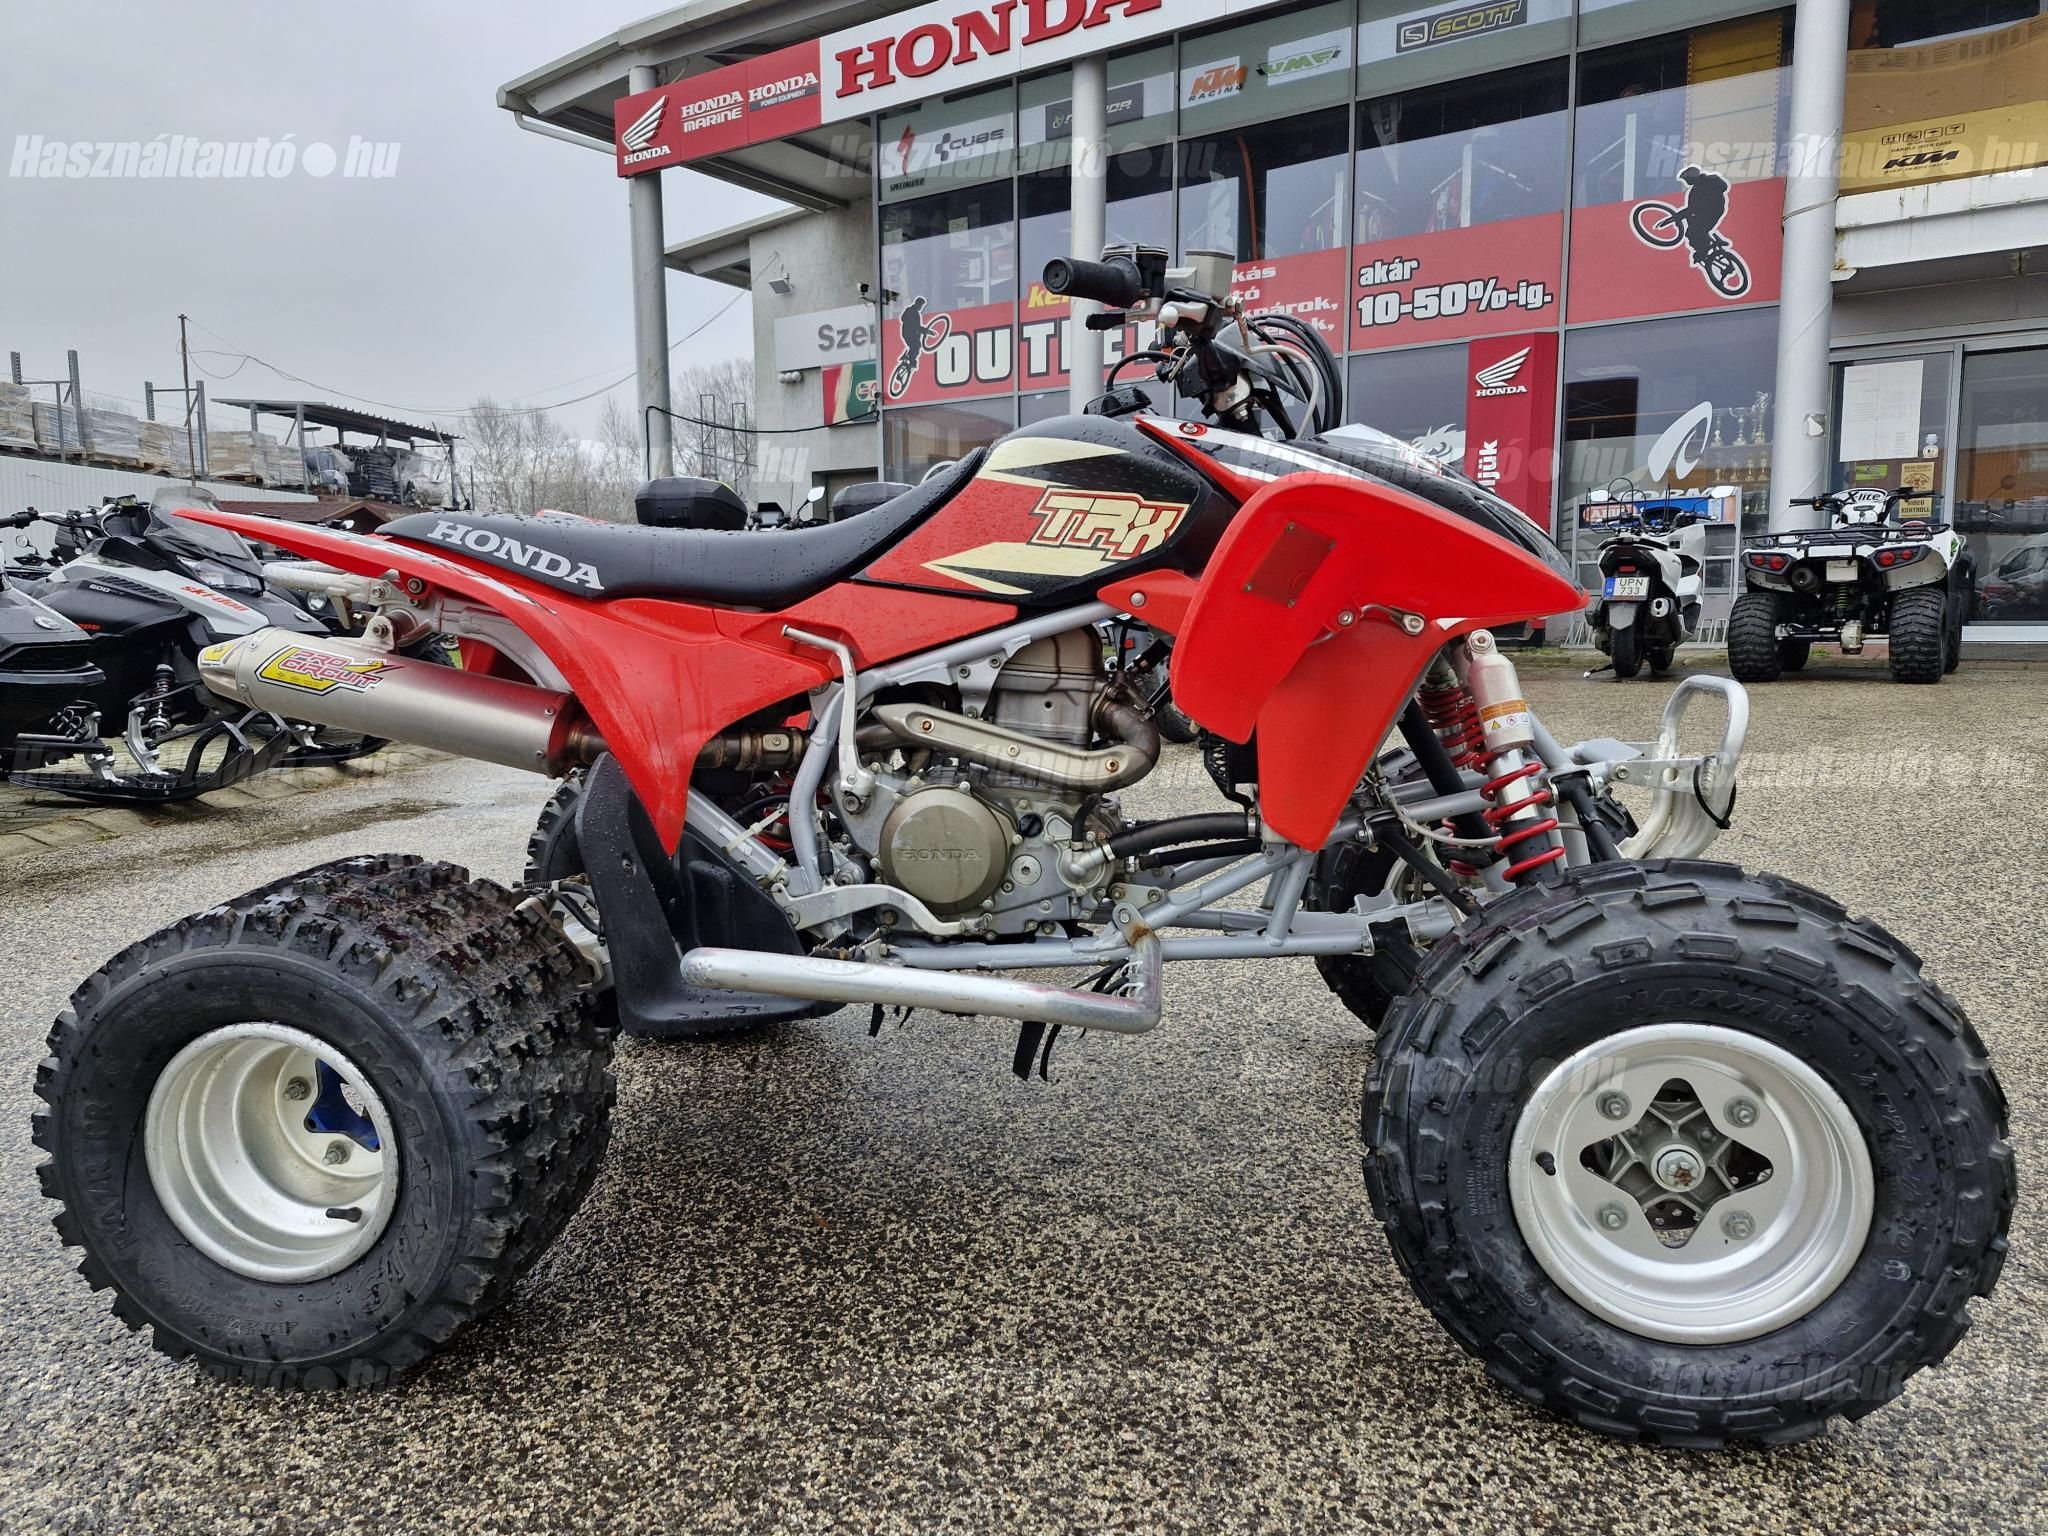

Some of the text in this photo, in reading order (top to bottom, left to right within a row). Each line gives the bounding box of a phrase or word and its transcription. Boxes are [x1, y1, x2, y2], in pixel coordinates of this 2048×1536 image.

[1434, 1, 1520, 37] SCOTT
[747, 71, 819, 102] HONDA
[1190, 63, 1249, 96] KTM
[680, 90, 745, 118] HONDA
[760, 97, 778, 108] POWER
[1188, 83, 1244, 102] RACING
[683, 107, 743, 133] MARINE
[949, 128, 1005, 150] CUBE
[623, 145, 672, 165] HONDA
[1882, 149, 1960, 170] KTM
[1231, 265, 1277, 283] kás
[1359, 257, 1420, 288] akár
[1357, 277, 1553, 328] 10-50%-ig.
[1475, 385, 1528, 397] HONDA
[1477, 439, 1501, 493] ljük
[1040, 492, 1182, 557] TRX
[427, 520, 605, 591] HONDA
[1619, 578, 1644, 587] UPN
[1620, 586, 1641, 595] 733
[291, 649, 350, 668] PRO
[278, 658, 382, 688] CIRCUIT
[900, 848, 983, 862] HONDA
